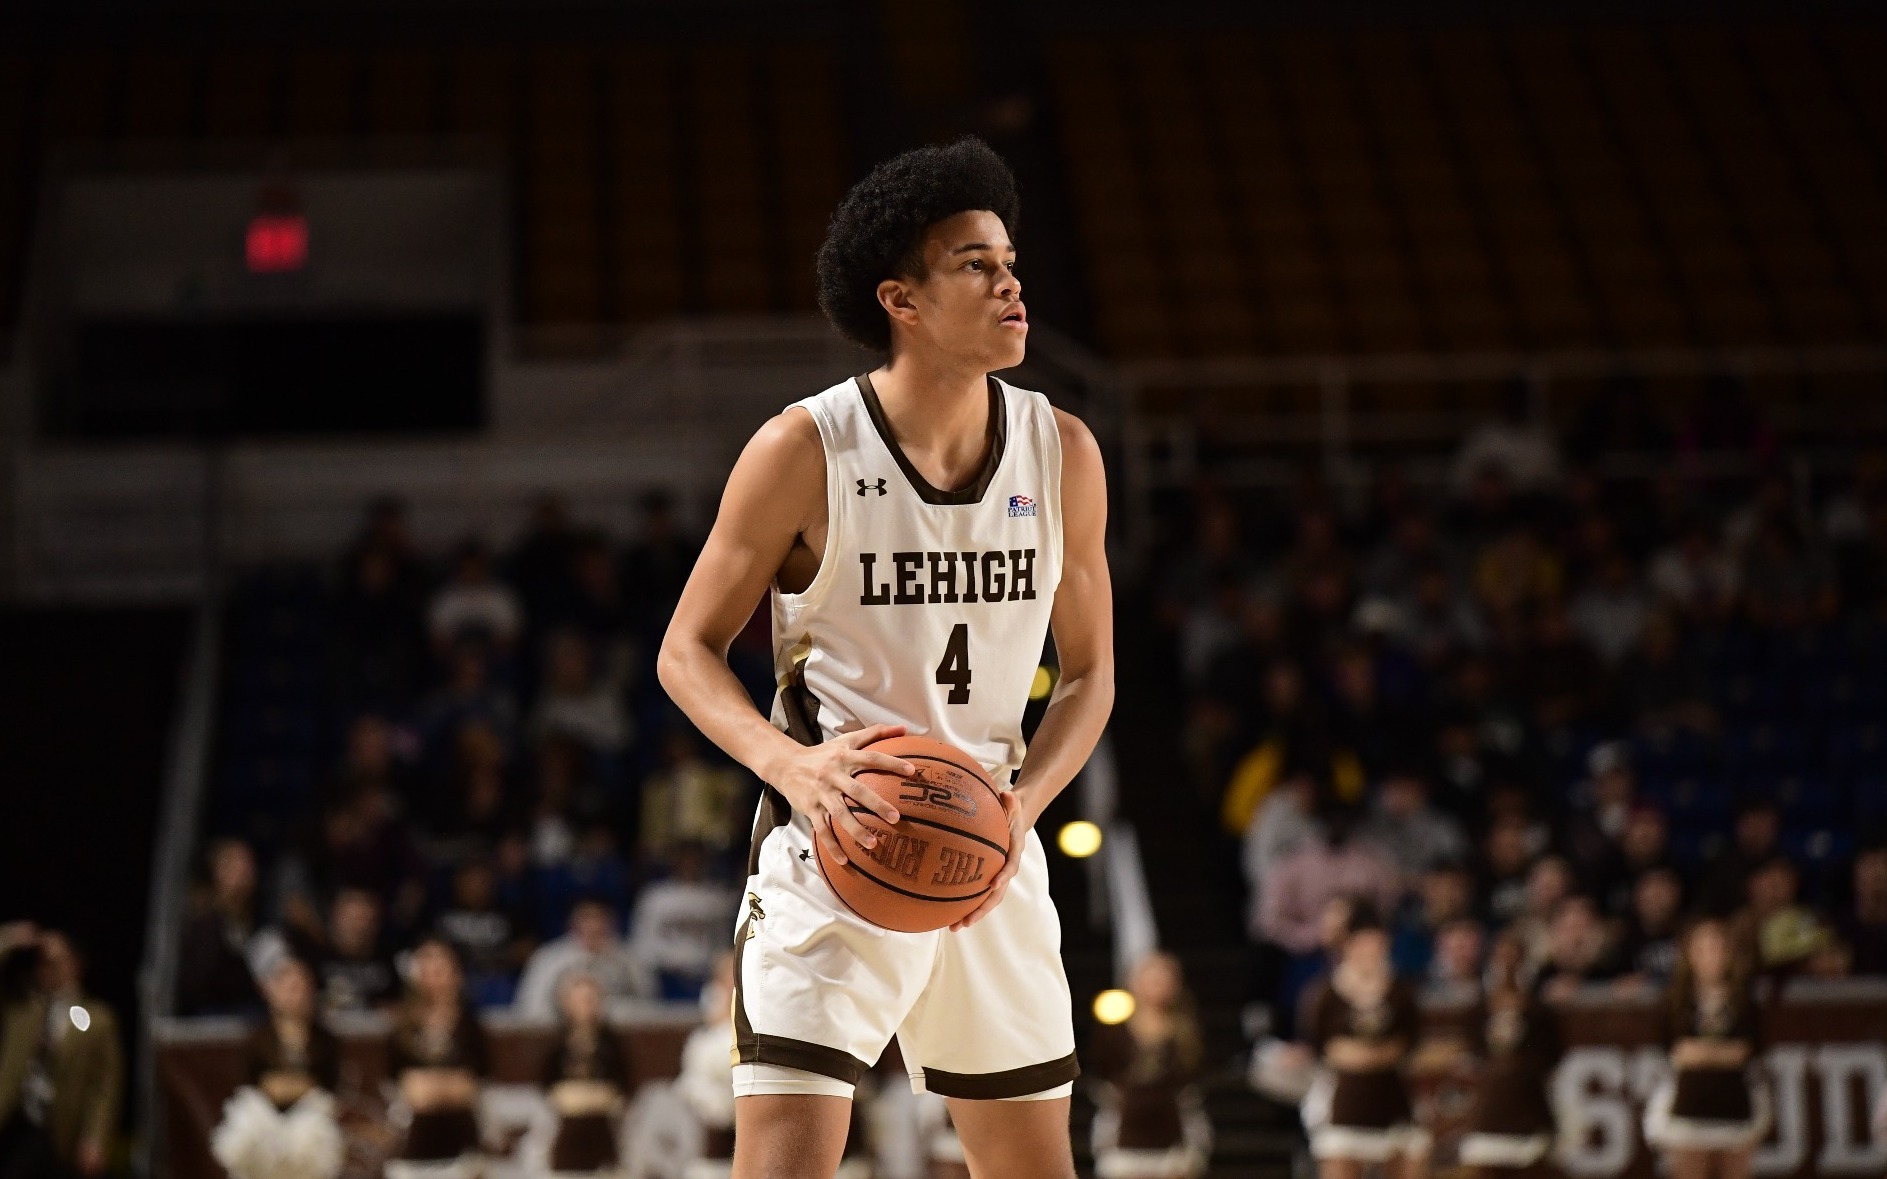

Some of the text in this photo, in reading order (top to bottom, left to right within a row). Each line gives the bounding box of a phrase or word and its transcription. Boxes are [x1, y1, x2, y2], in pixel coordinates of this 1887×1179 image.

[860, 549, 1036, 605] LEHIGH
[935, 623, 972, 704] 4
[931, 846, 985, 886] THE
